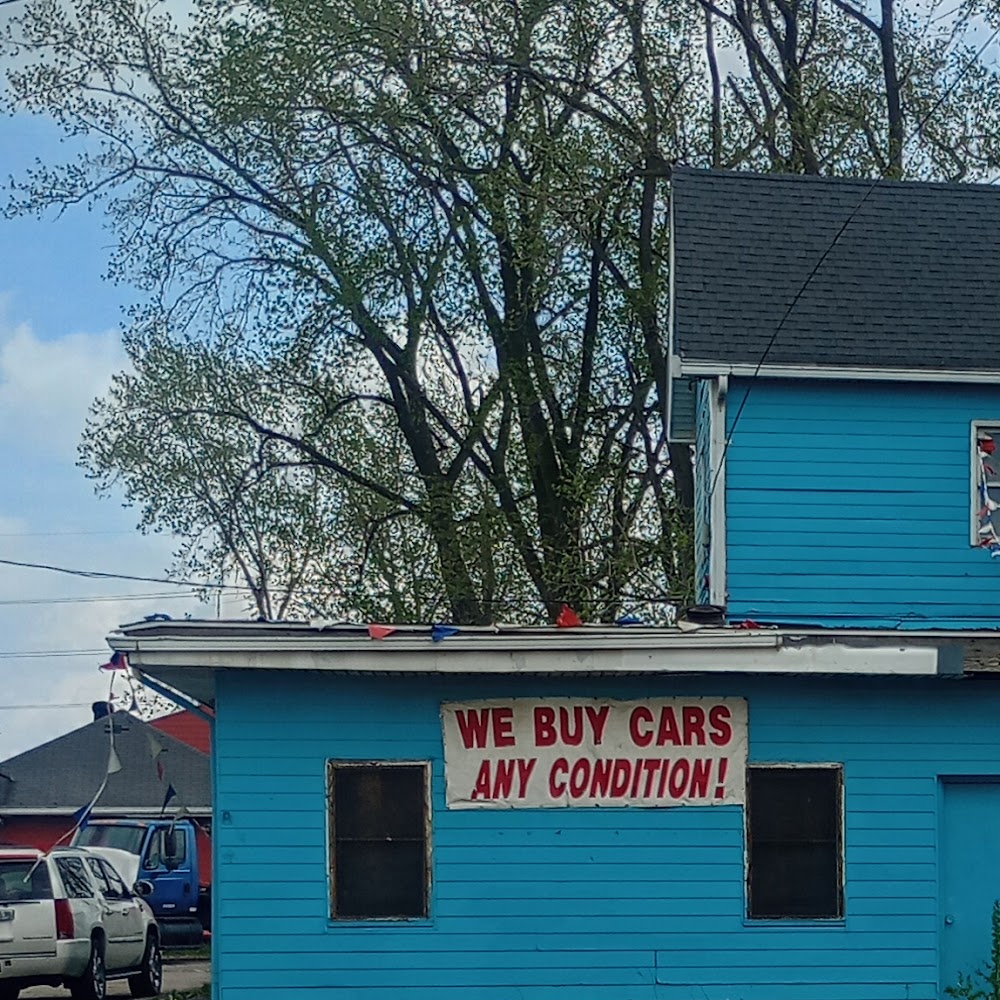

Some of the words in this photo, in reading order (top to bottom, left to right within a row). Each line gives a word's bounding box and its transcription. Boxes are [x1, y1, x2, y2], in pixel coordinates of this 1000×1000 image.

[455, 707, 516, 749] WE
[534, 705, 610, 747] BUY
[629, 705, 733, 747] CARS
[471, 758, 538, 801] ANY
[549, 757, 729, 800] CONDITION!
